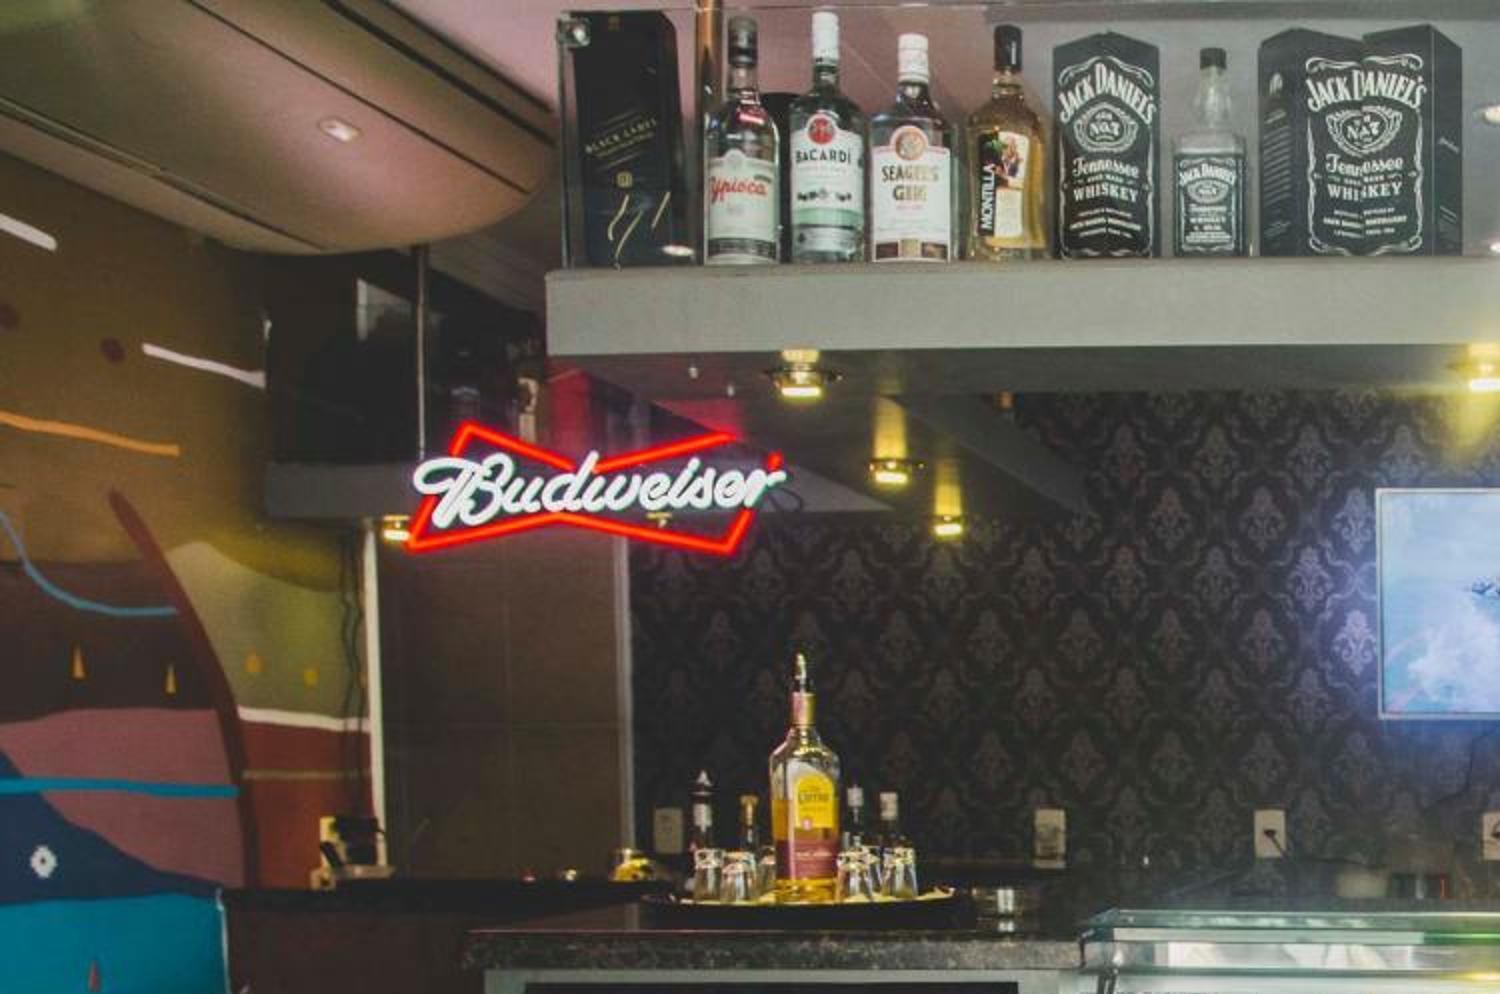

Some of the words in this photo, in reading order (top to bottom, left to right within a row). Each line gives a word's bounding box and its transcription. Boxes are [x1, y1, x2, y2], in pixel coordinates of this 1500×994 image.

[1059, 74, 1096, 124] JACK
[1305, 76, 1352, 112] JACK
[1352, 69, 1427, 109] DANIEL'S
[981, 163, 996, 230] MONTILLA
[1073, 182, 1139, 202] WHISKEY
[413, 449, 787, 528] Budweiser
